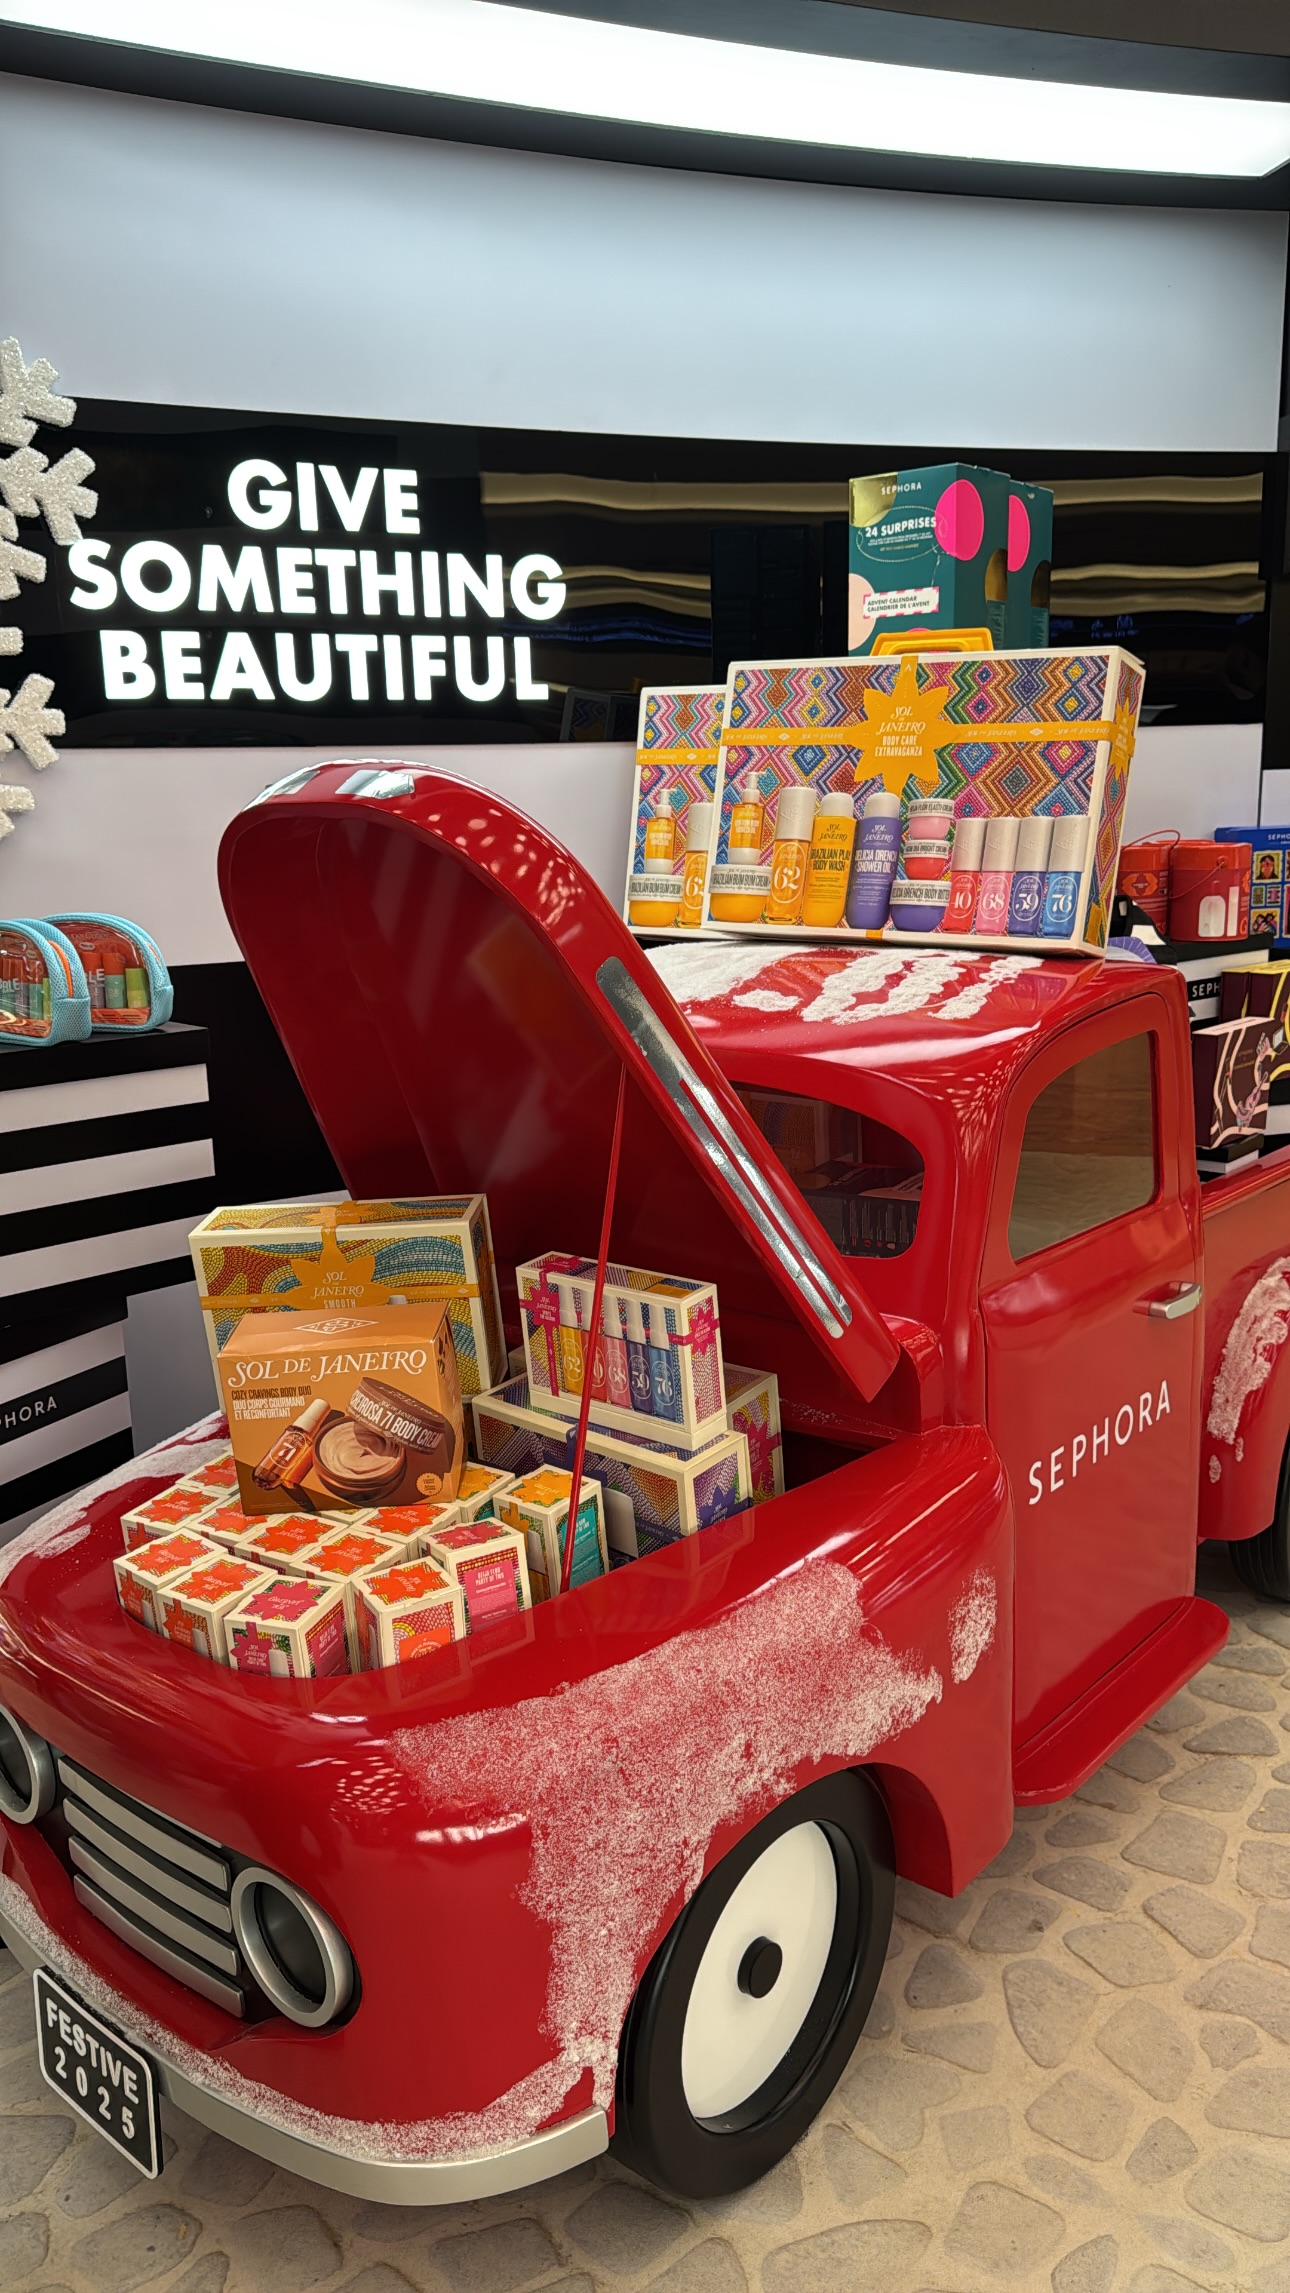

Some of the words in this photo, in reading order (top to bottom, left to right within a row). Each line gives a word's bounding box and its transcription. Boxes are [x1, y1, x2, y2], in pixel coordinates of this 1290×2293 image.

[227, 458, 420, 534] GIVE
[881, 482, 922, 495] SEPHORA
[865, 527, 878, 538] 24
[881, 516, 937, 536] SURPRISES
[68, 538, 567, 621] SOMETHING
[867, 604, 898, 612] CALENDRIER
[889, 596, 917, 604] CALENDAR
[100, 630, 549, 702] BEAUTIFUL
[890, 706, 914, 720] SOL
[875, 721, 926, 736] JANEIRO
[882, 735, 900, 746] BODY
[901, 735, 918, 746] CARE
[875, 746, 923, 757] EXTRAVAGANZA
[774, 866, 800, 890] 62
[982, 893, 1005, 911] 68
[1015, 893, 1039, 911] 59
[1052, 894, 1072, 913] 76
[322, 1271, 347, 1283] SOL
[311, 1286, 365, 1300] JANEIRO
[323, 1299, 356, 1309] SMOOTH
[228, 1360, 279, 1388] SOL
[283, 1357, 311, 1374] DE
[310, 1349, 427, 1382] JANEIRO
[564, 1356, 581, 1373] 62
[608, 1366, 627, 1384] 68
[631, 1371, 650, 1391] 59
[231, 1389, 248, 1400] COZY
[248, 1387, 280, 1400] CRAVINGS
[280, 1386, 297, 1398] BODY
[298, 1385, 312, 1396] DUO
[654, 1376, 673, 1397] 76
[233, 1399, 246, 1410] DUO
[247, 1398, 269, 1409] CORPS
[269, 1396, 305, 1409] GOURMAND
[234, 1410, 243, 1420] ET
[349, 1389, 384, 1424] CHEIROSA
[380, 1410, 395, 1430] 71
[390, 1416, 422, 1442] BODY
[416, 1428, 445, 1449] CREAM
[1028, 1379, 1171, 1505] SEPHORA
[278, 1442, 297, 1461] 71
[46, 1997, 140, 2105] FESTIVE
